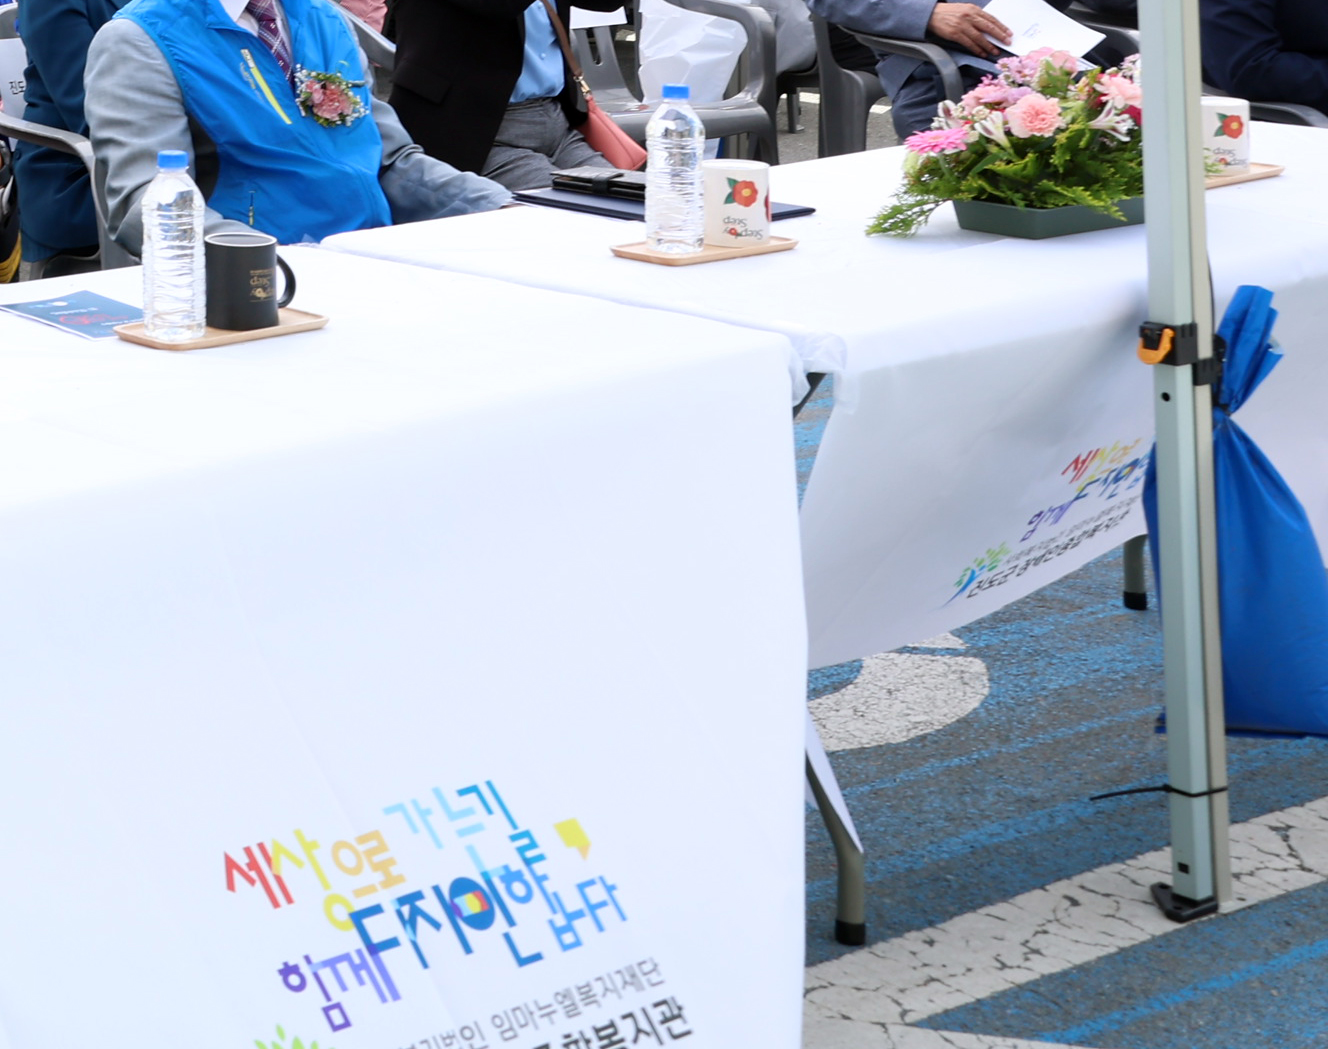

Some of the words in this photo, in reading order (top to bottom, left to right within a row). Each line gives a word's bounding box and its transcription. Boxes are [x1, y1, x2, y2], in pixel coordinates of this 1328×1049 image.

[8, 80, 25, 95] 진도
[224, 829, 407, 932] 세상으로
[277, 946, 403, 1033] 함께
[490, 956, 666, 1042] 임마누엘복지재단
